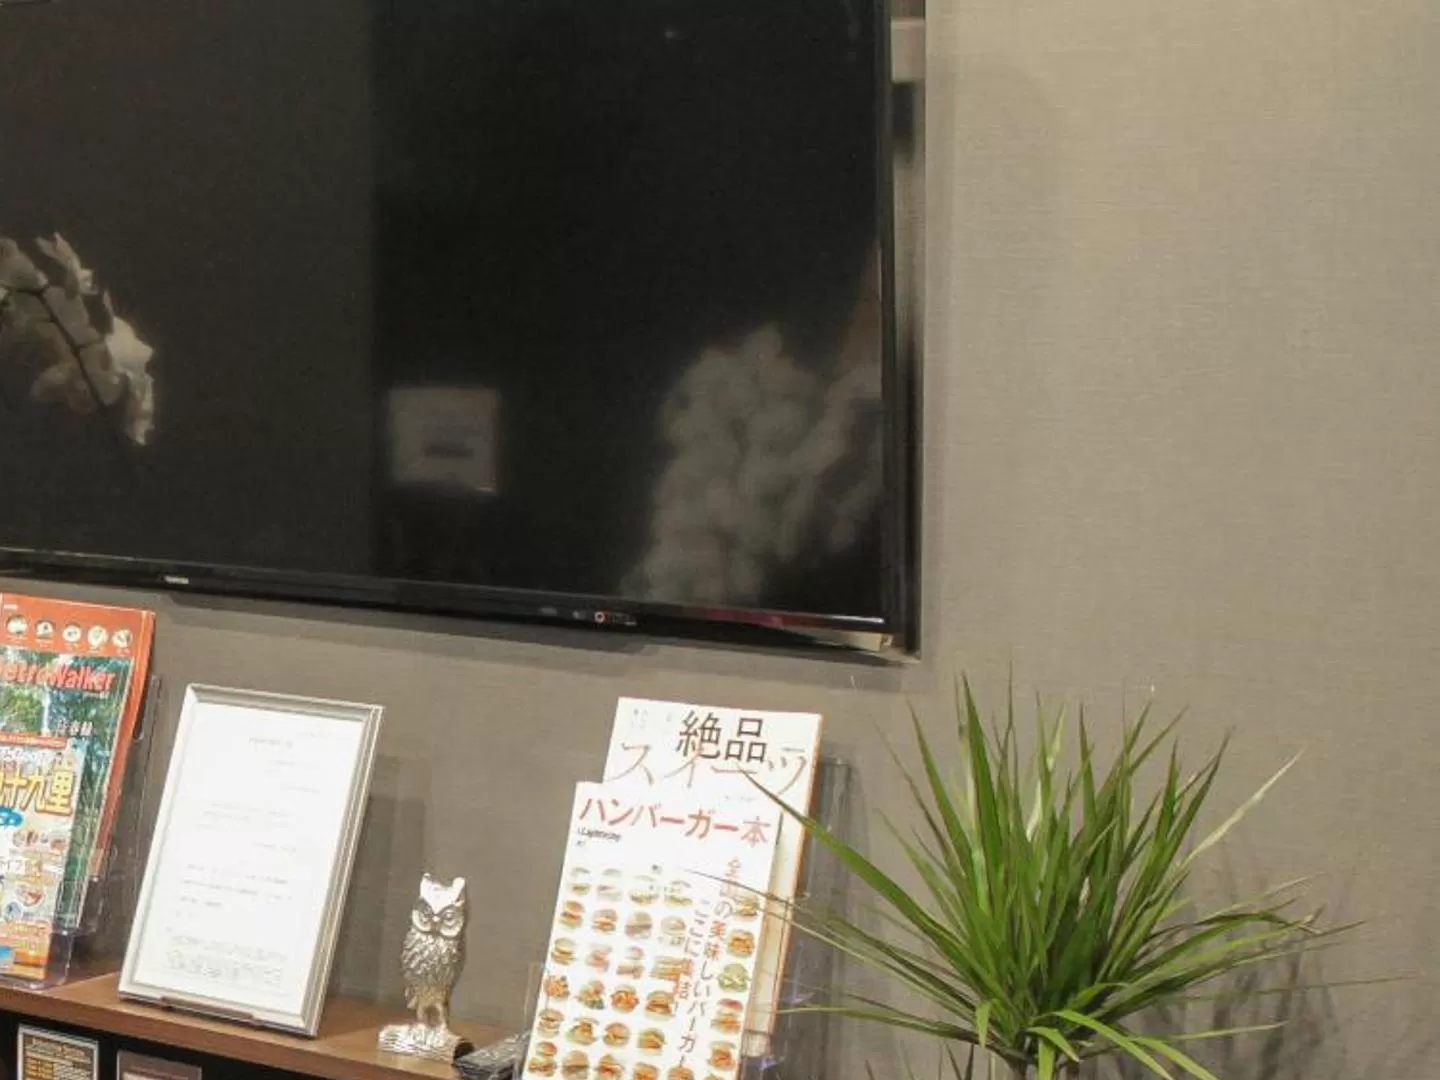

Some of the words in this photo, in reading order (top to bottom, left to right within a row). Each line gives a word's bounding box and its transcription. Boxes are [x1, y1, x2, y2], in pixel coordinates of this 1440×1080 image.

[676, 709, 768, 763] 絶品
[579, 798, 771, 848] ハンバーガー本
